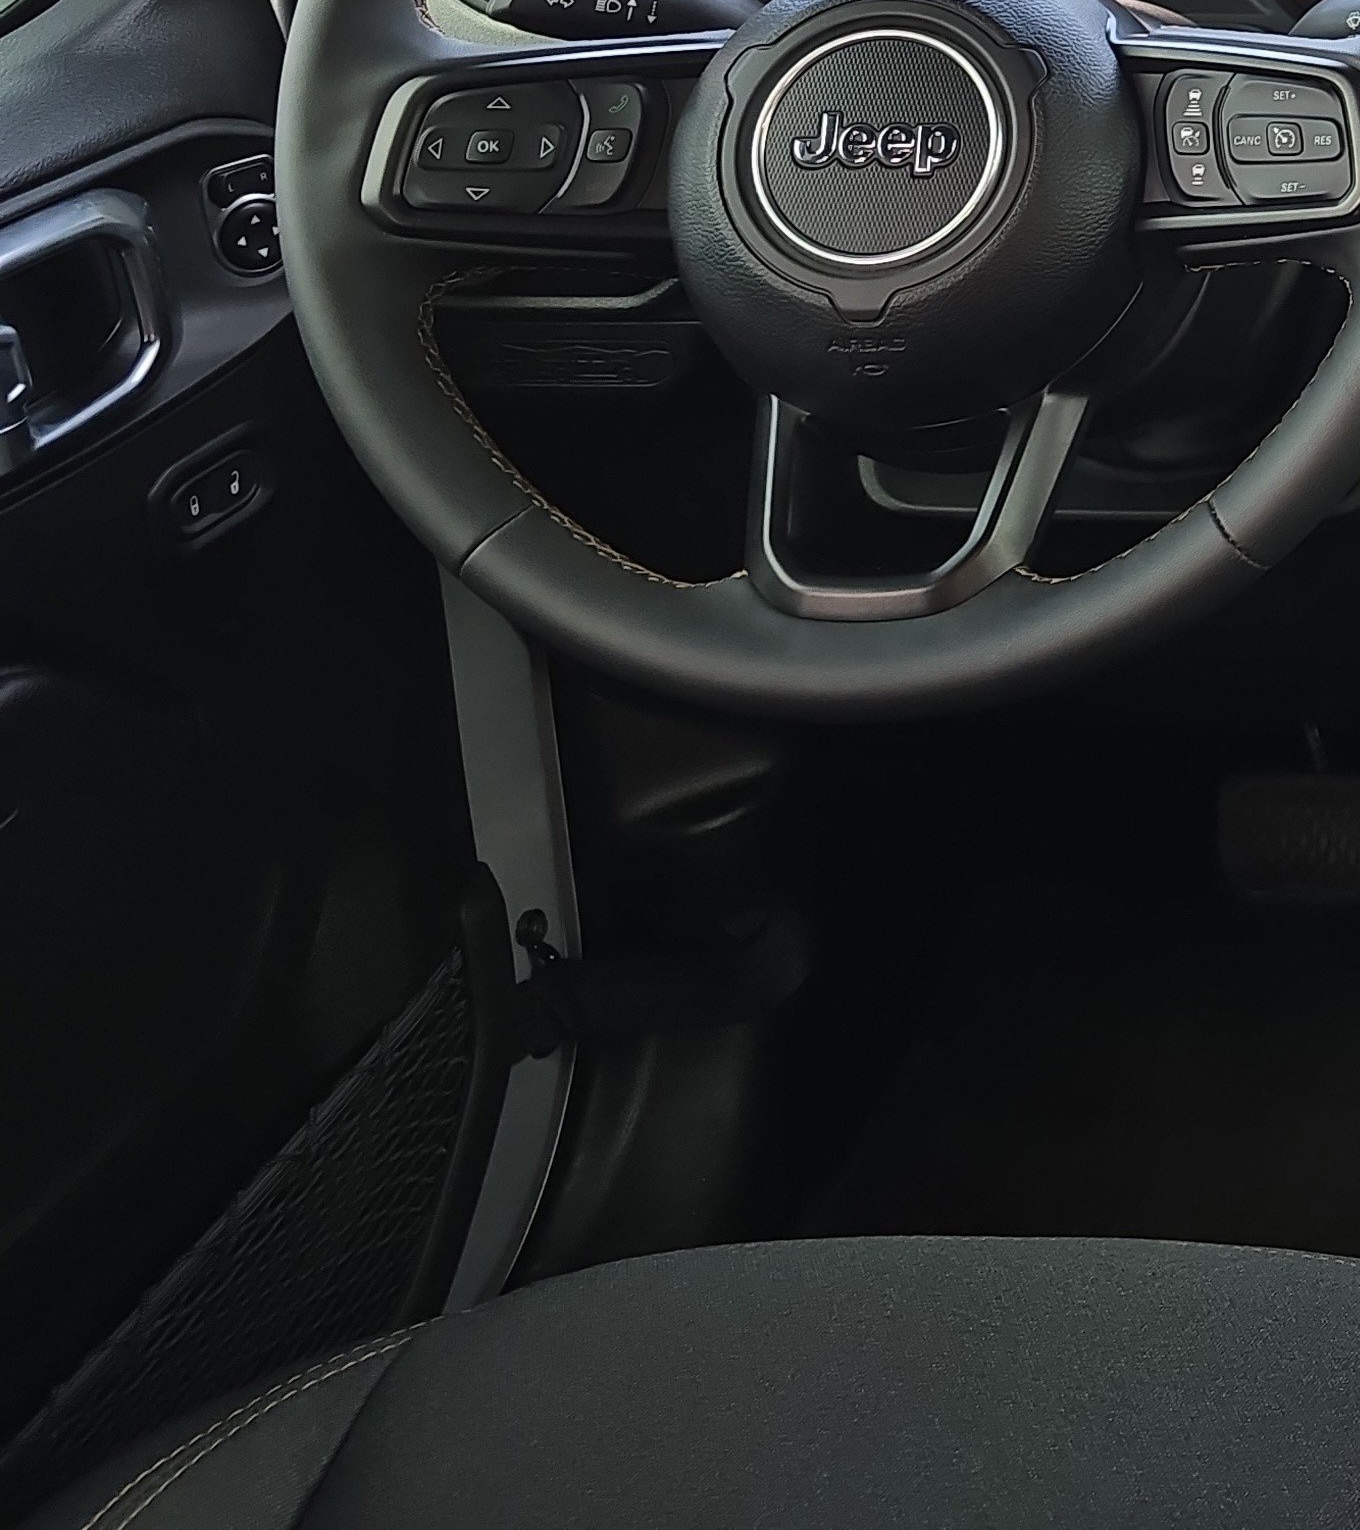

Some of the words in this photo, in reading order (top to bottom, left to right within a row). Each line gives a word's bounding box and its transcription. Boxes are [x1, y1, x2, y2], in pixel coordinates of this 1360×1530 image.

[791, 110, 963, 177] Jeep
[1233, 135, 1262, 146] CANC
[1313, 135, 1333, 146] RES
[477, 140, 500, 154] OK
